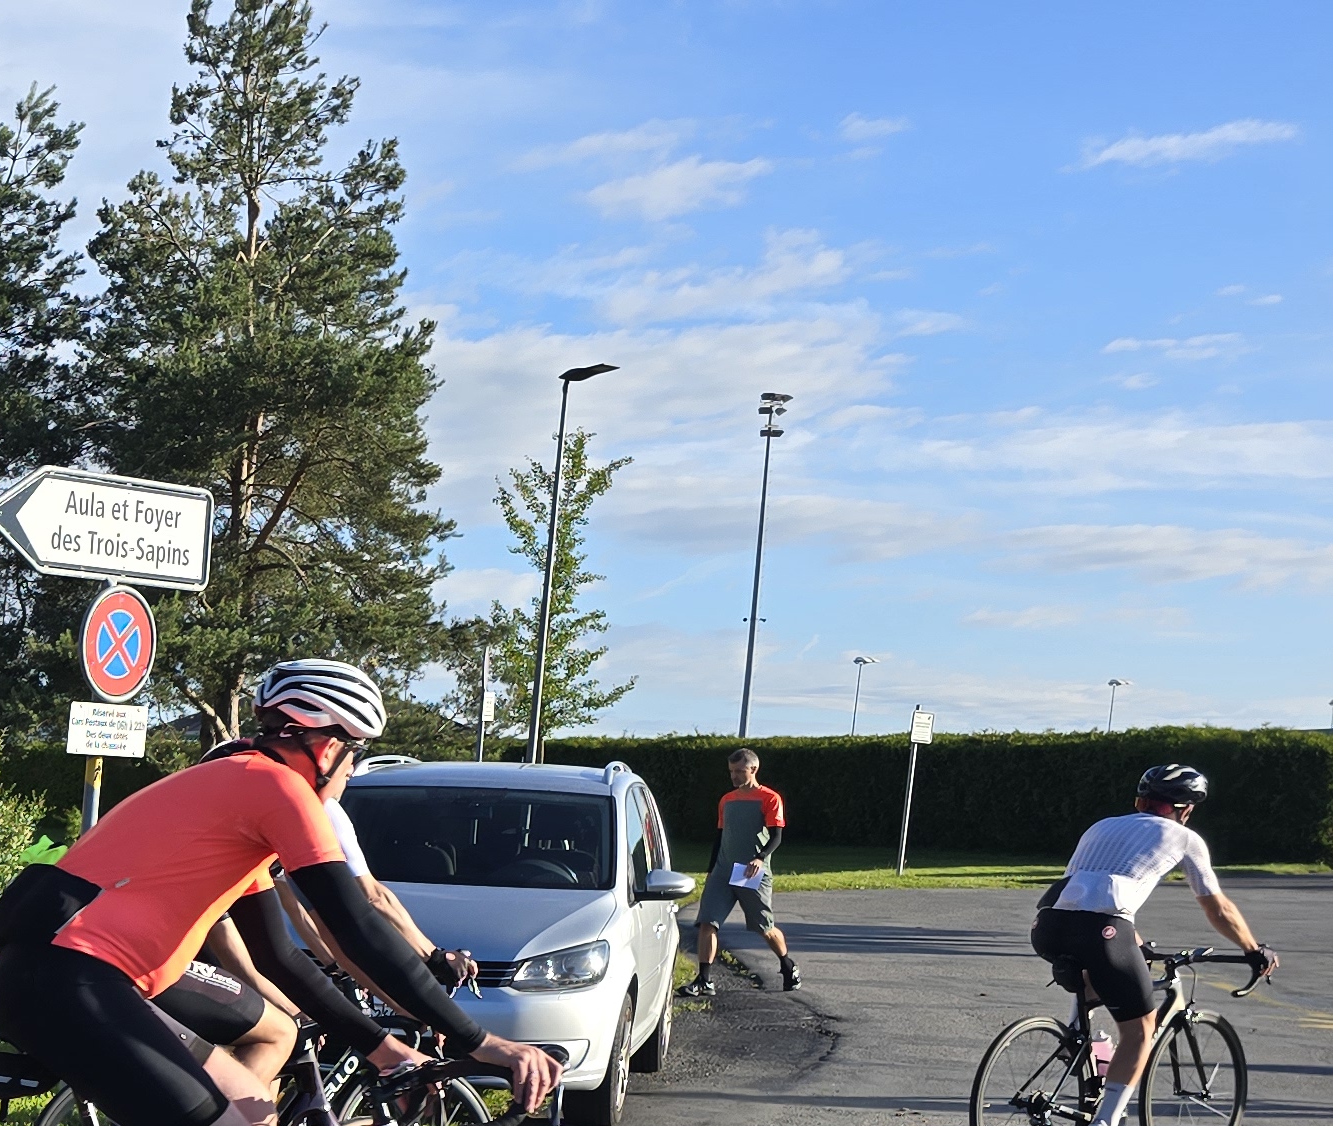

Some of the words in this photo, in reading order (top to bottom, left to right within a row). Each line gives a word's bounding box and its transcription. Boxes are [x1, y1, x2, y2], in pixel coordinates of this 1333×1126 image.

[65, 491, 105, 519] Aula
[111, 500, 129, 522] et
[134, 500, 181, 533] Foyer
[51, 525, 81, 553] des
[87, 530, 190, 570] Trois-Sapins
